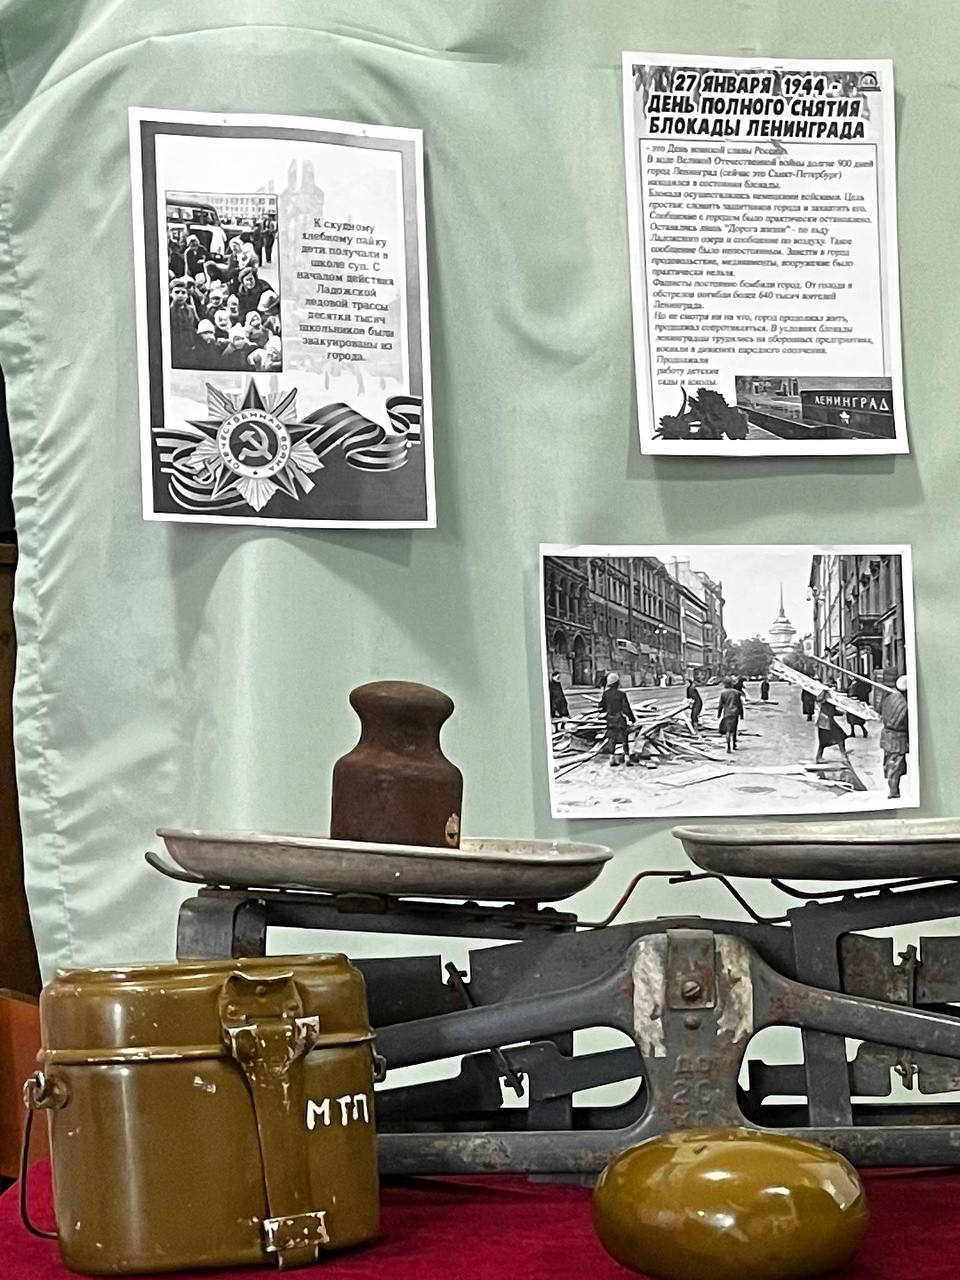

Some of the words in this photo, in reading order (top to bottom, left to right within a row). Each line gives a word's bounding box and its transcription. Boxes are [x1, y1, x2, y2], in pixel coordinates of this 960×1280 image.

[675, 73, 697, 92] 27
[702, 75, 772, 94] ЯНВАРЯ
[784, 77, 825, 95] 1944
[648, 95, 694, 113] ДЕНЬ
[701, 98, 784, 115] ПОЛНОГО
[791, 100, 861, 117] СНЯТИЯ
[649, 117, 741, 137] БЛОКАДЫ
[746, 120, 865, 140] ЛЕНИНГРАДА
[815, 395, 889, 411] ЛЕНИНГРАД
[306, 1094, 369, 1130] МТП
